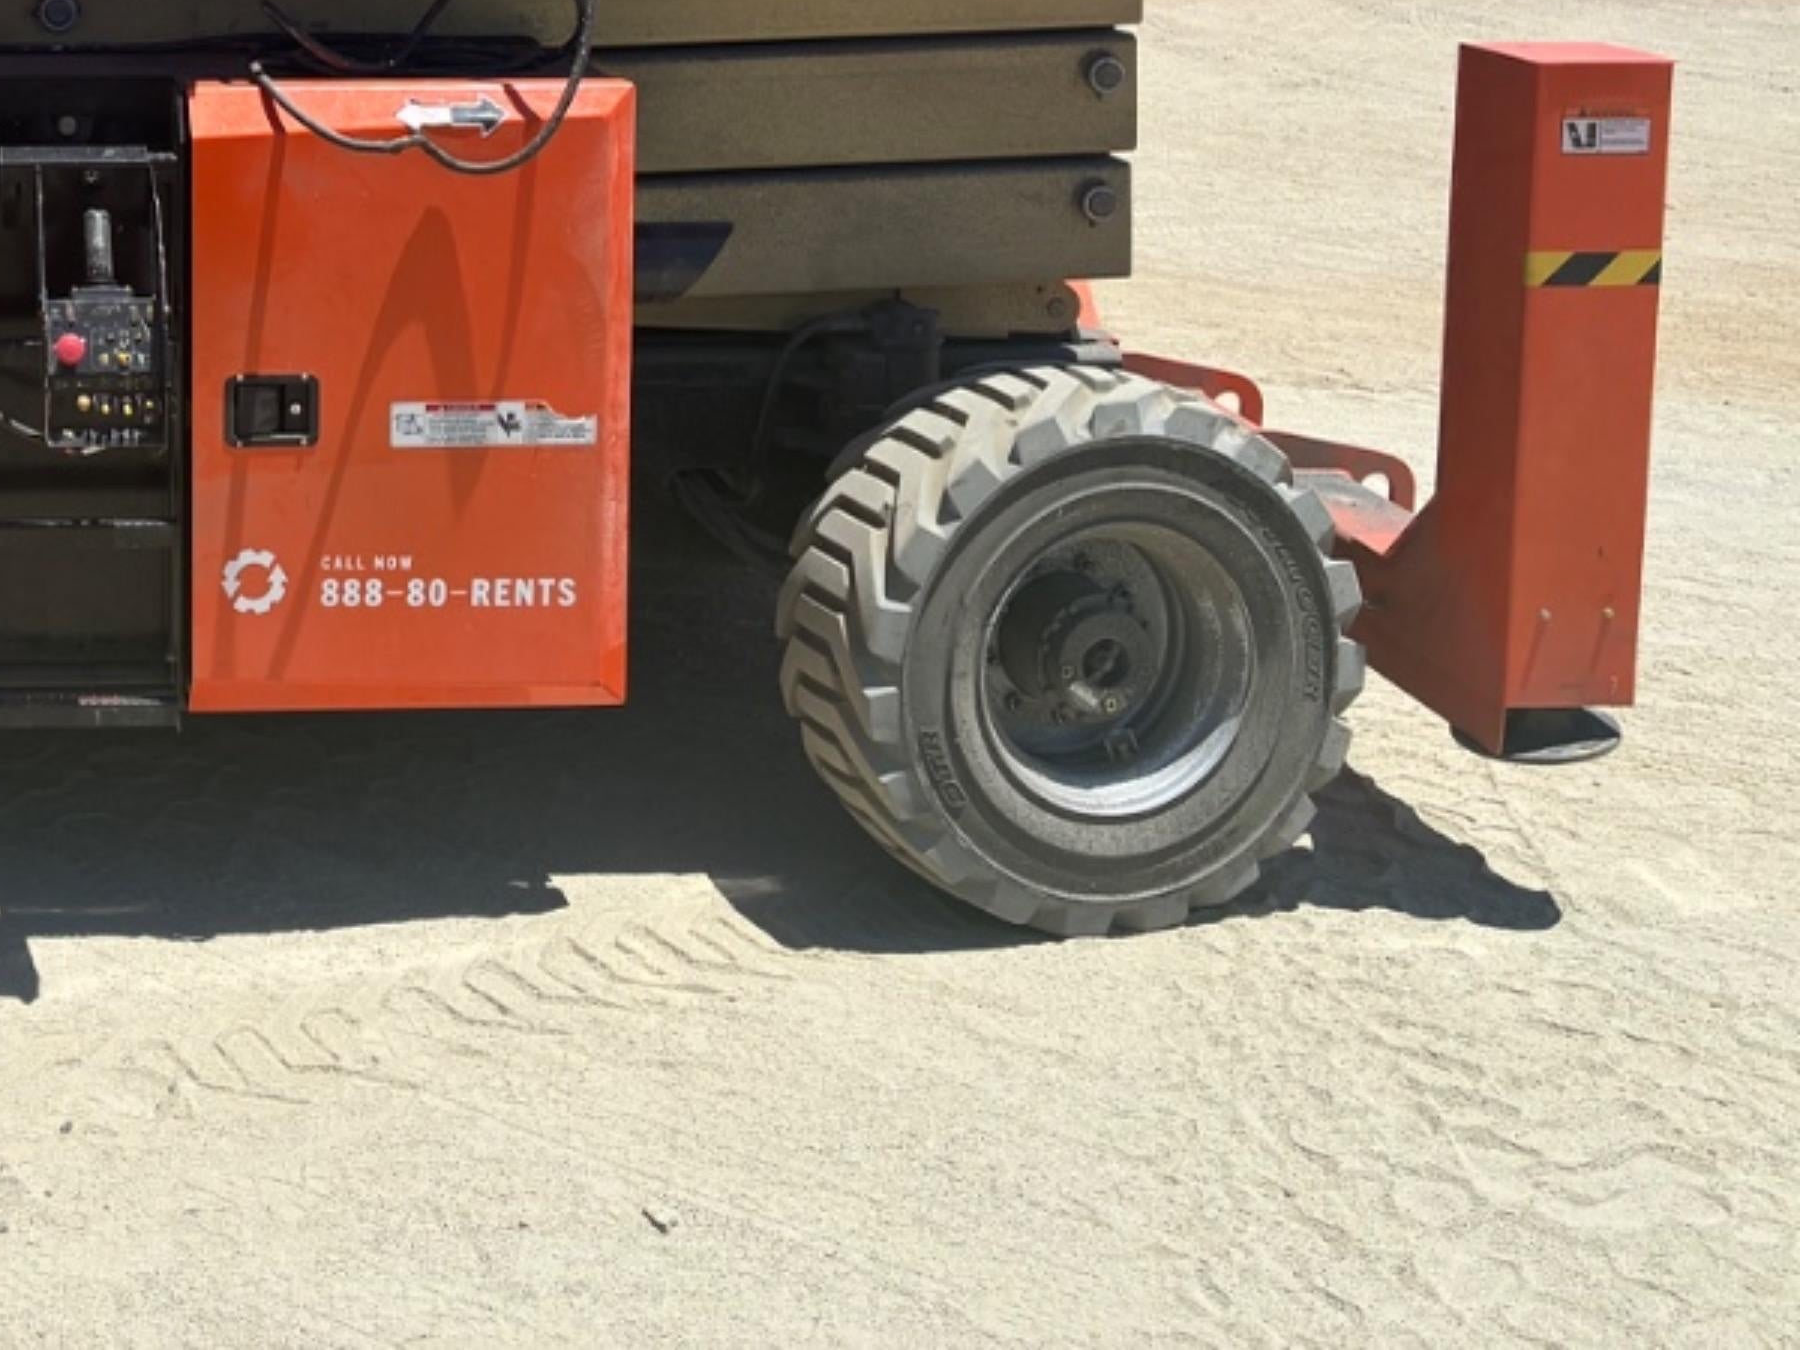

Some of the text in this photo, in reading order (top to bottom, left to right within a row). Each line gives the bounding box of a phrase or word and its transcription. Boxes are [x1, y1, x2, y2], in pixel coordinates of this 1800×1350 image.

[319, 555, 414, 571] CALL NOW
[319, 578, 577, 608] 888-80-RENTS
